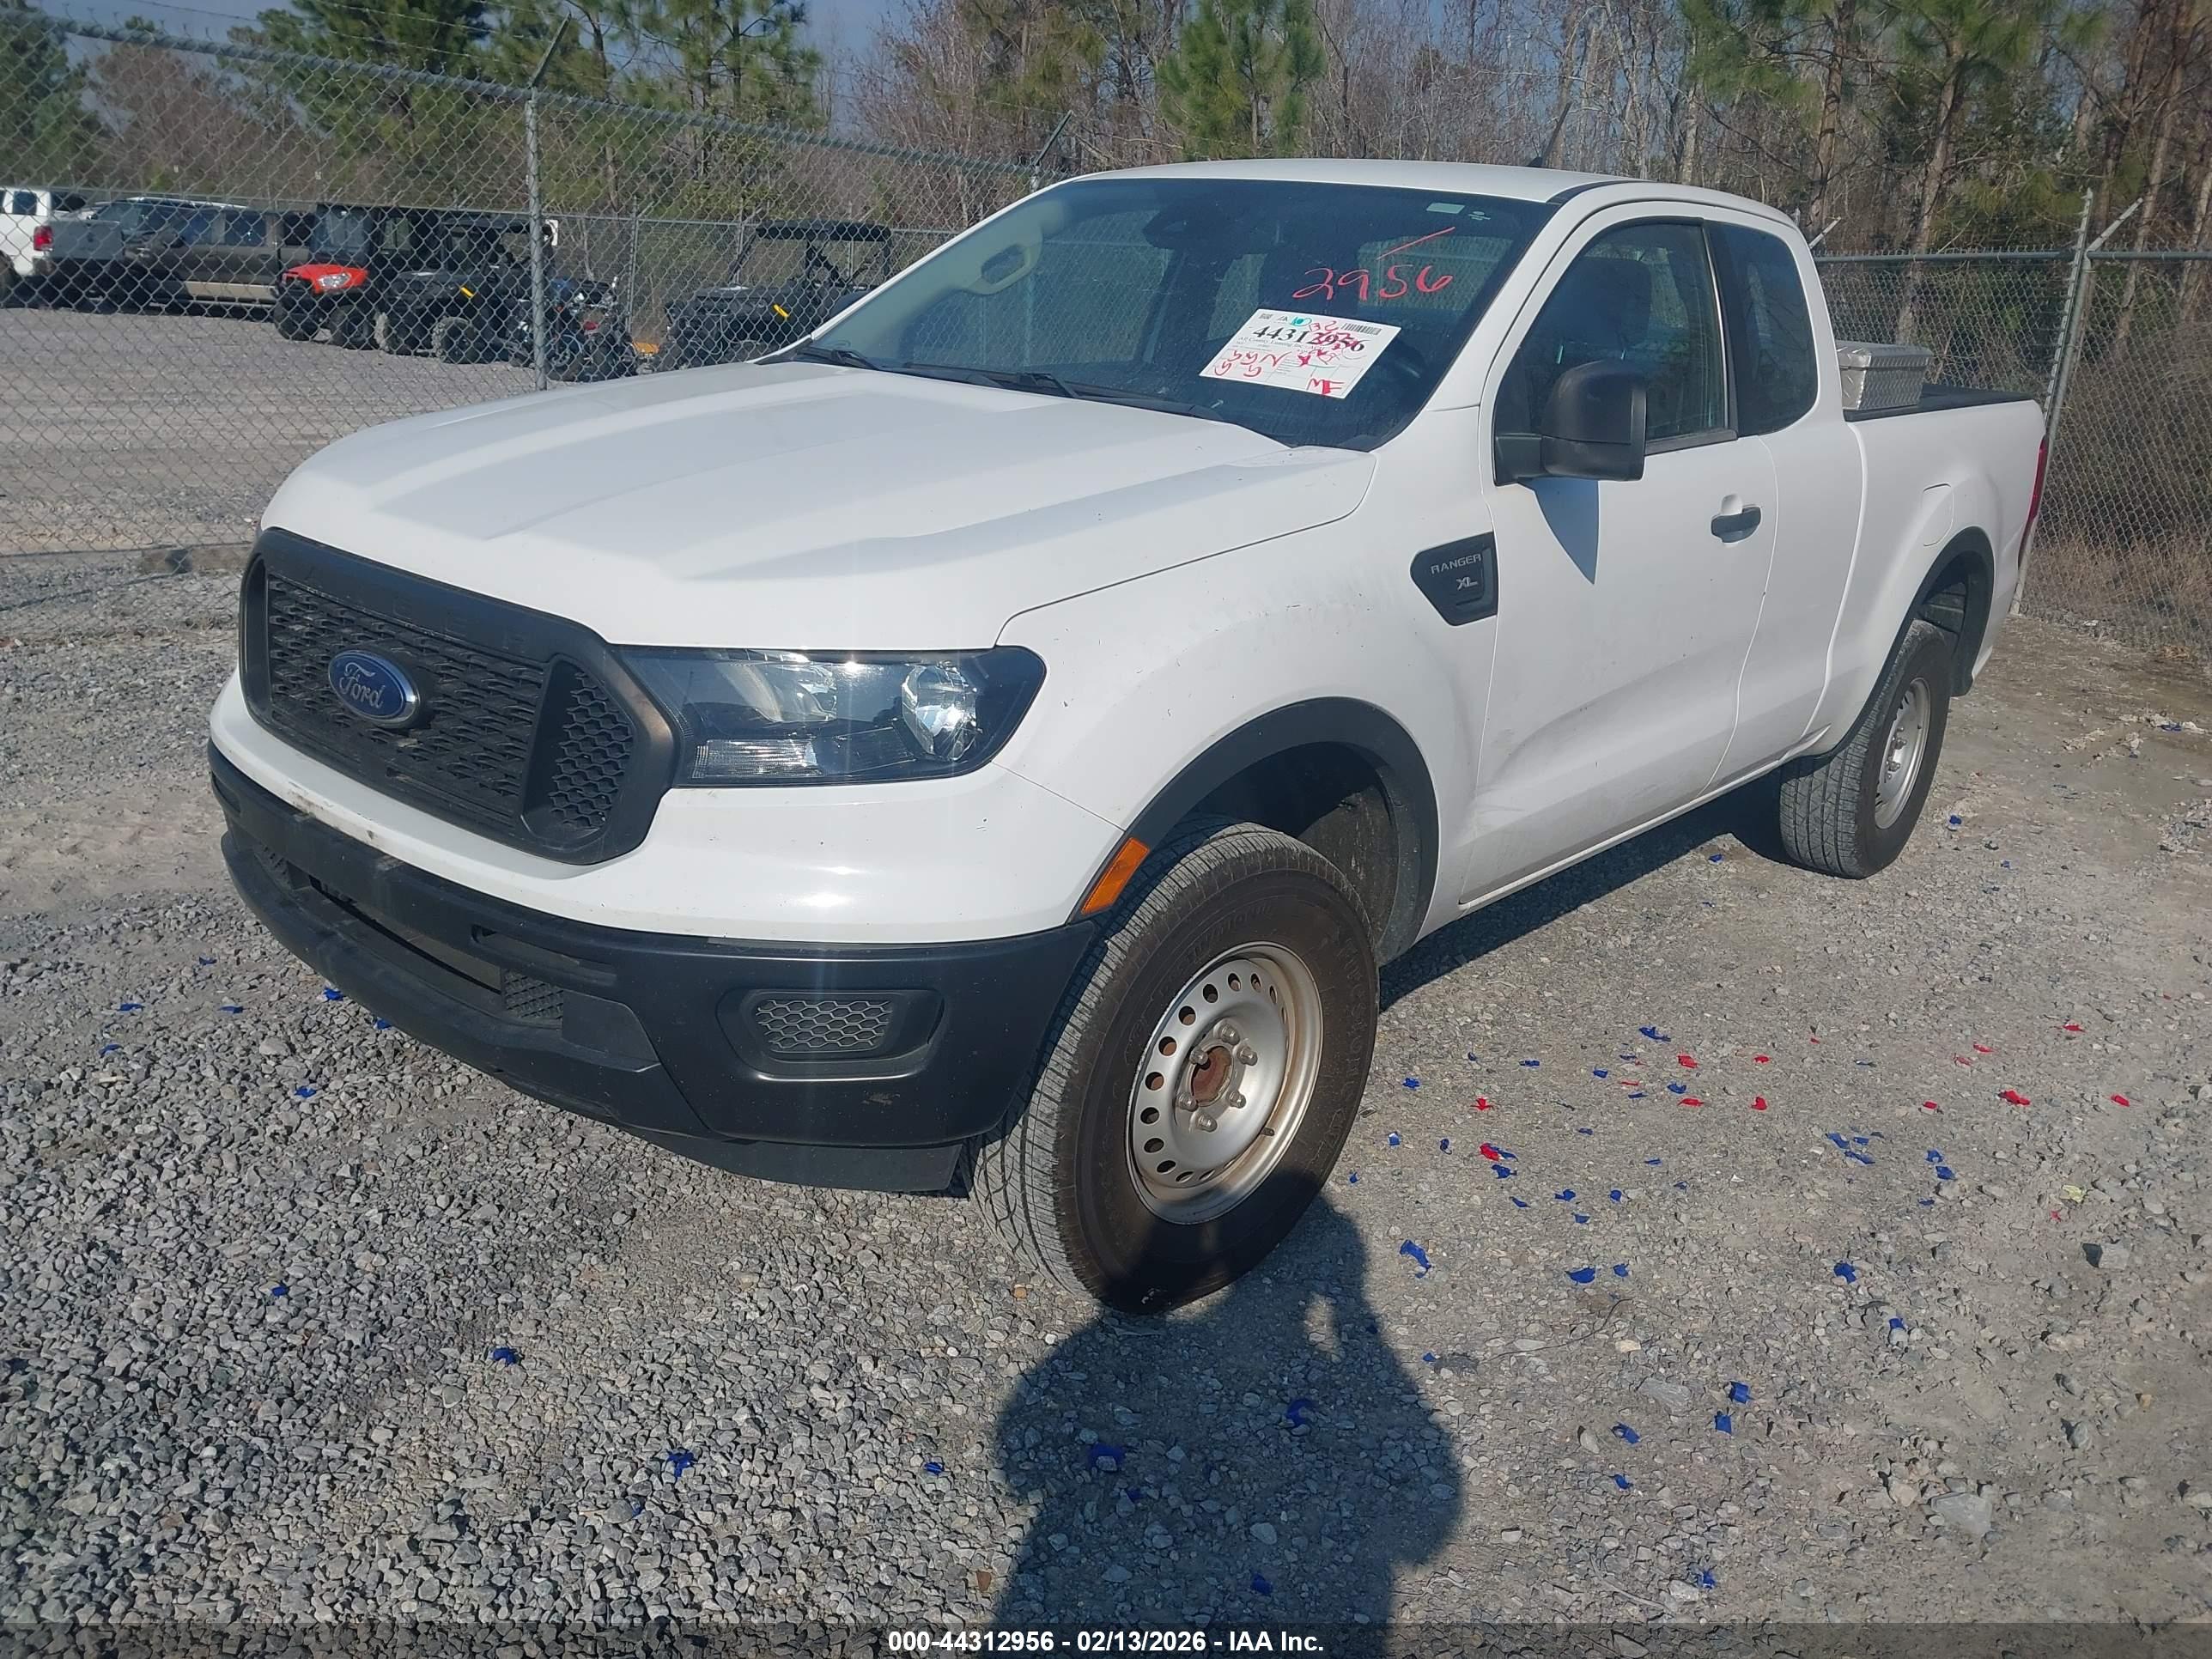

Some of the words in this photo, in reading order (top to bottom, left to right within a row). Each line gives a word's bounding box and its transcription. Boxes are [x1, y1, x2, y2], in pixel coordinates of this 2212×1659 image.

[1292, 264, 1454, 301] 2956
[1431, 553, 1482, 574] RANGER
[1455, 576, 1478, 591] XL
[339, 662, 386, 708] Ford
